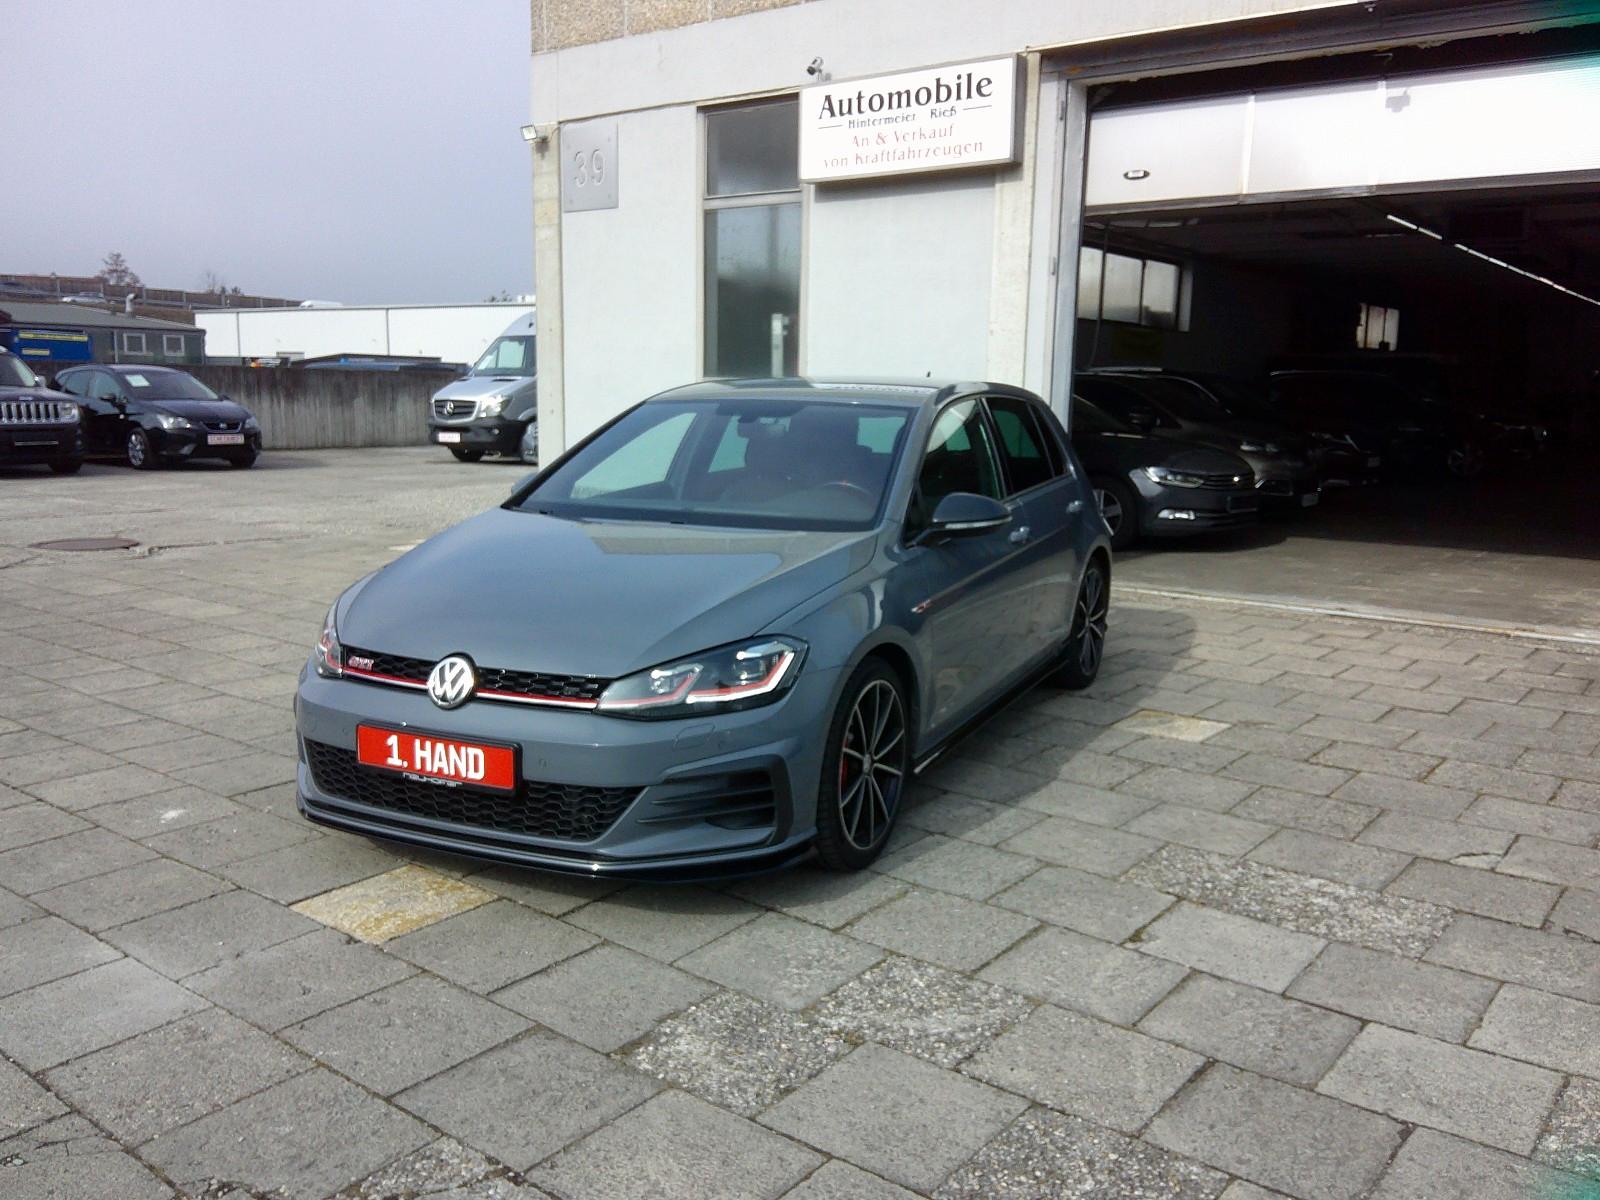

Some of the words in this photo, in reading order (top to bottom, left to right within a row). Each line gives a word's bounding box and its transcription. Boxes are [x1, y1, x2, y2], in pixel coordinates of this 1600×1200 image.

[818, 72, 993, 120] Automobile
[848, 112, 916, 129] Hintermeier
[852, 134, 869, 148] An
[875, 131, 888, 145] &
[893, 124, 955, 143] Verkauf
[574, 148, 606, 188] 39
[823, 155, 848, 169] von
[855, 141, 983, 166] Kraftfahrzeugen
[429, 656, 475, 707] VW
[386, 734, 408, 768] 1.
[414, 738, 485, 780] HAND
